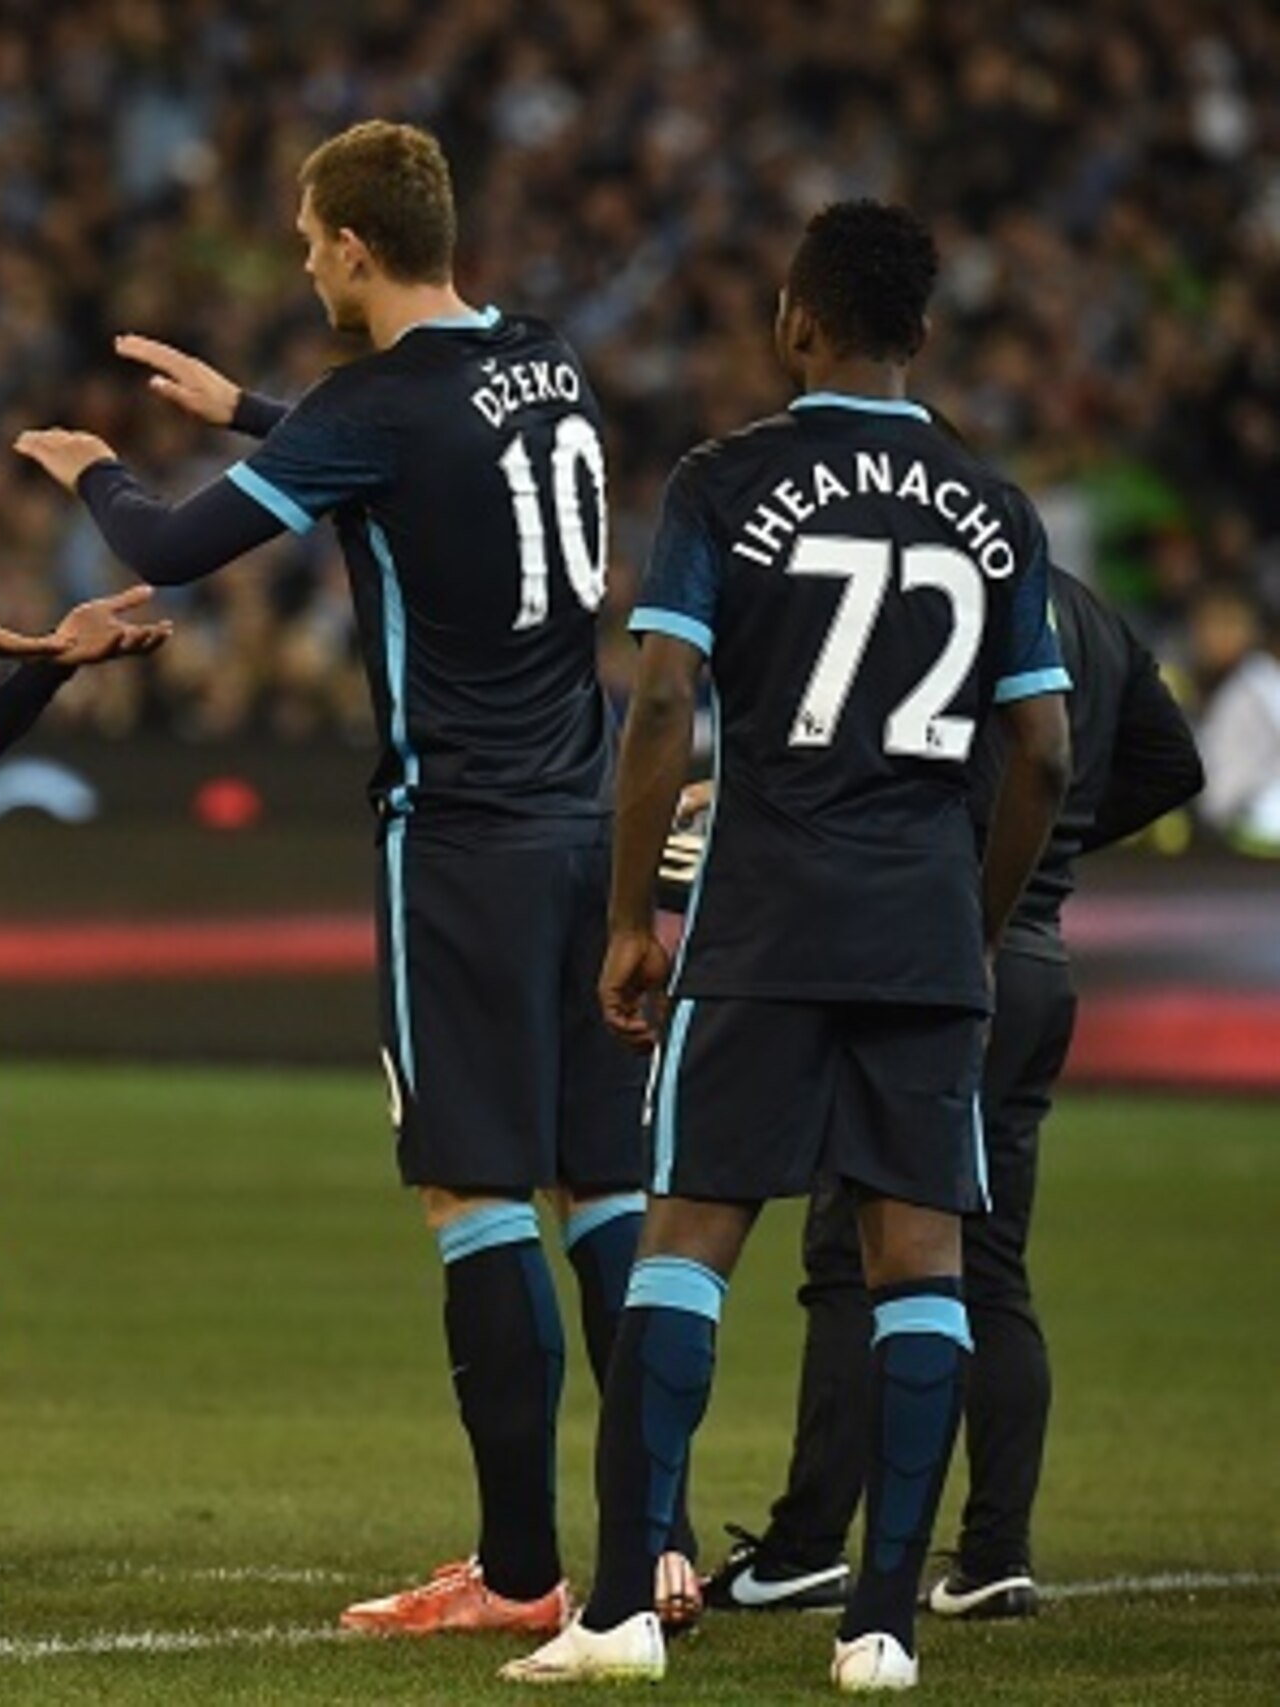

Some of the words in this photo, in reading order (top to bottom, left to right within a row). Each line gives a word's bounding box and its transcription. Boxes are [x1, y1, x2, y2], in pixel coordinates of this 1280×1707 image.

[499, 414, 608, 630] 10
[732, 452, 1016, 579] IHEANACHO
[785, 534, 985, 761] 72
